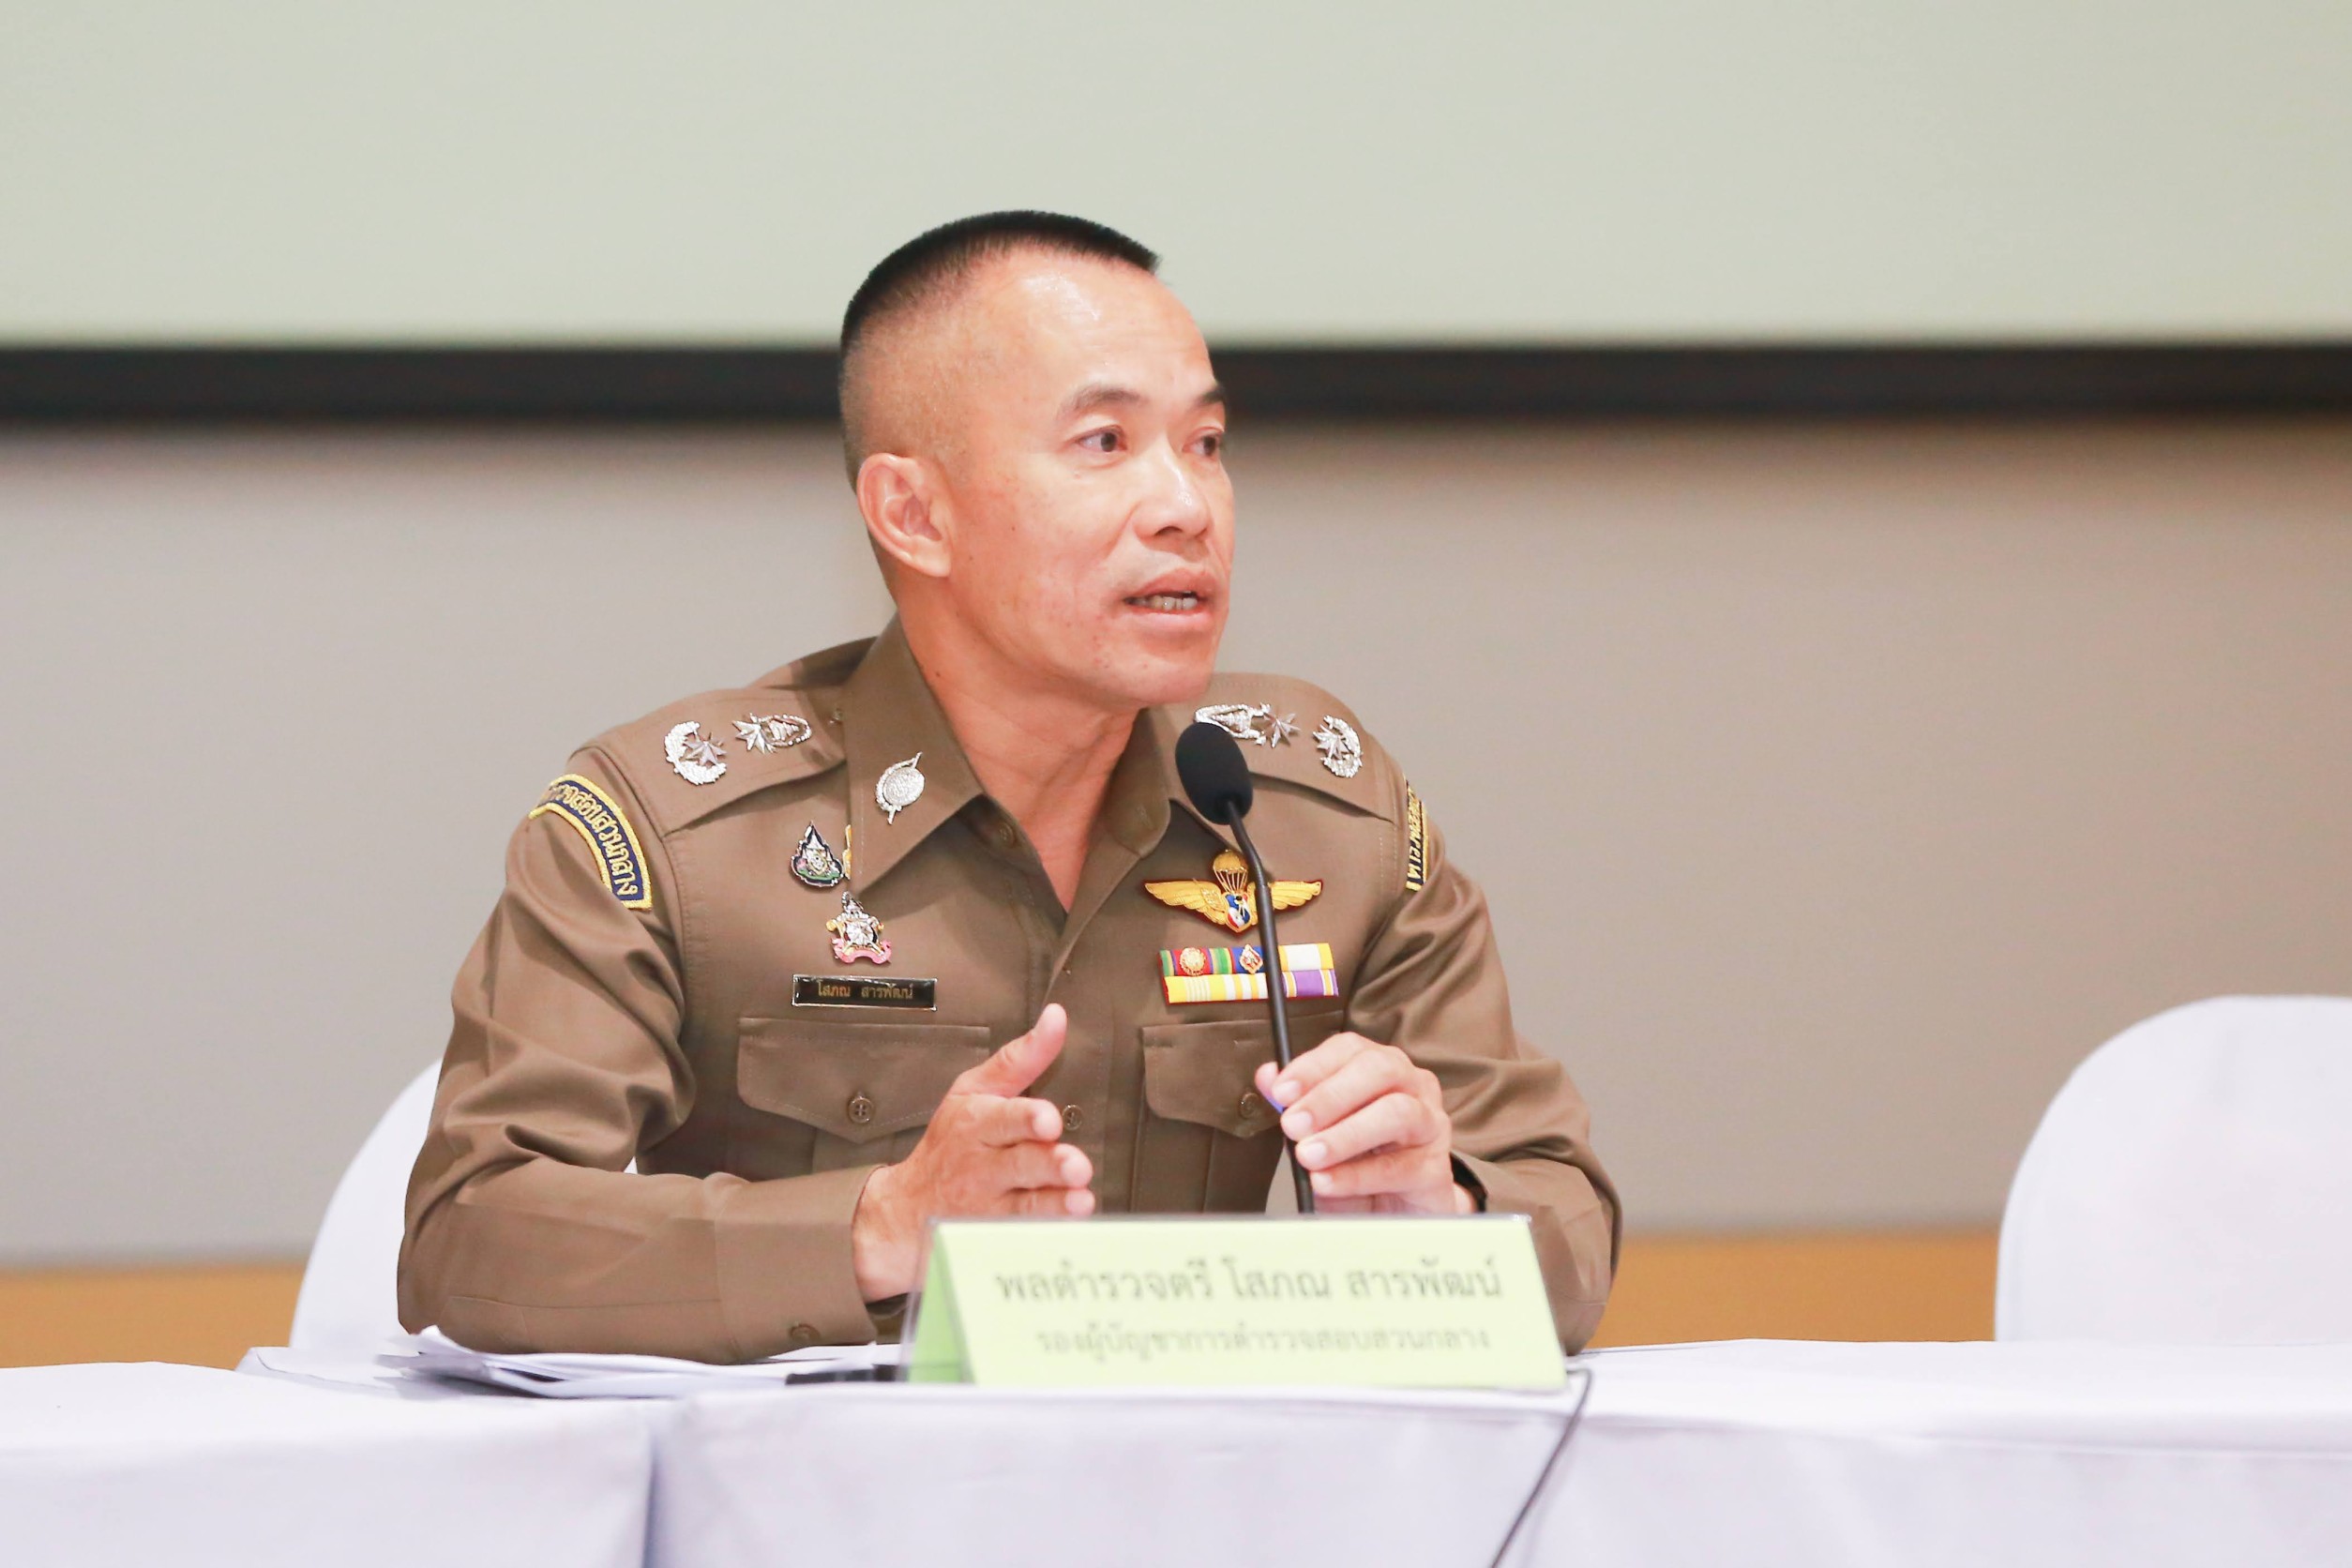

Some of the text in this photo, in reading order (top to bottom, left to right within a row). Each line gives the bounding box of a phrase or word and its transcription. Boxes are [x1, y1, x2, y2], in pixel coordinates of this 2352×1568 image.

[816, 978, 914, 1000] โสภณ สารพัฒน์
[995, 1253, 1502, 1302] พลตำรวจตรี โสภณ สารพัฒน์
